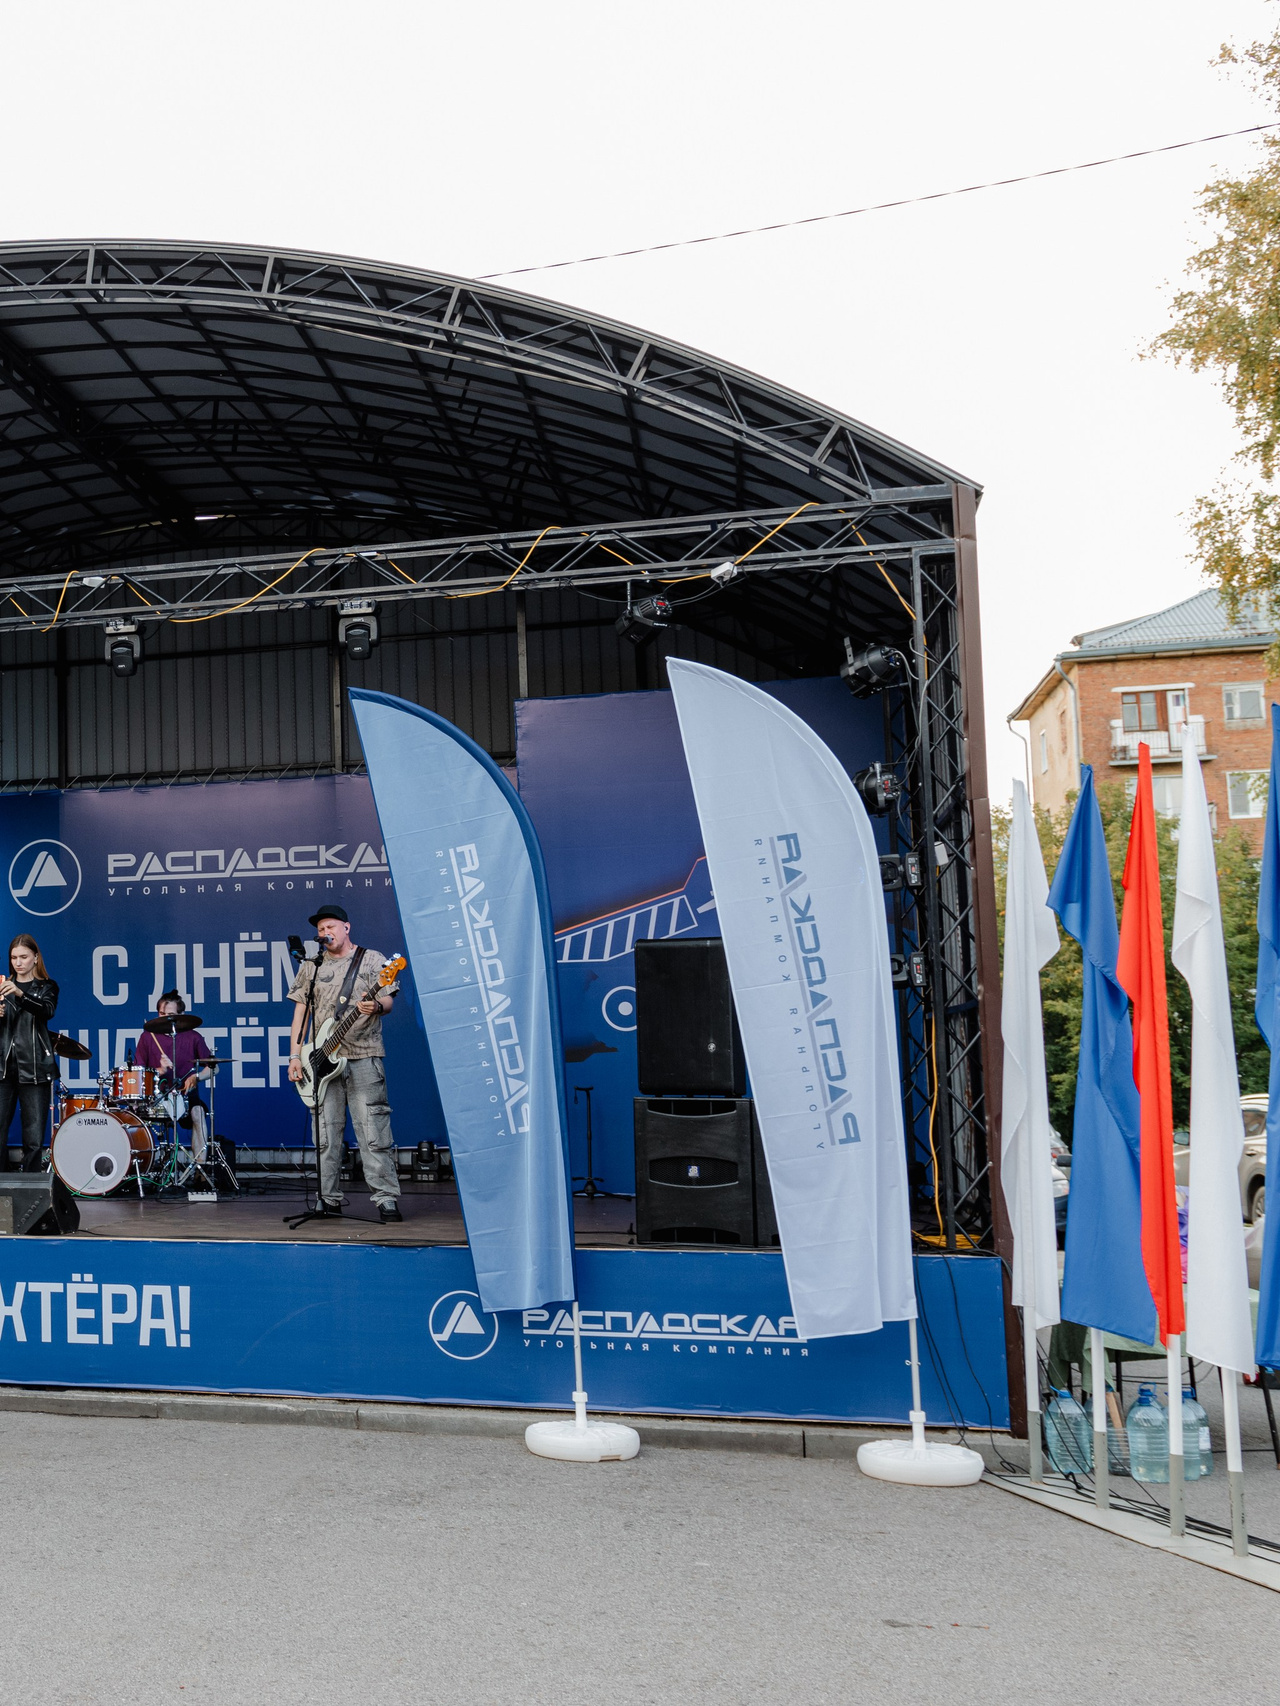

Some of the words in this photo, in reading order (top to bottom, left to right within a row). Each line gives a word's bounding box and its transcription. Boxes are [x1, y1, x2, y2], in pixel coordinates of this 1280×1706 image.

[108, 883, 242, 896] УГОЛЬНАЯ
[267, 878, 393, 892] КОМПАНИ
[92, 945, 129, 1006] С
[83, 1118, 109, 1126] YAMAHA
[522, 1309, 808, 1343] РАСПАДСКАЯ
[523, 1339, 650, 1352] УГОЬНАЯ
[672, 1344, 809, 1357] КОМПАНИЯ
